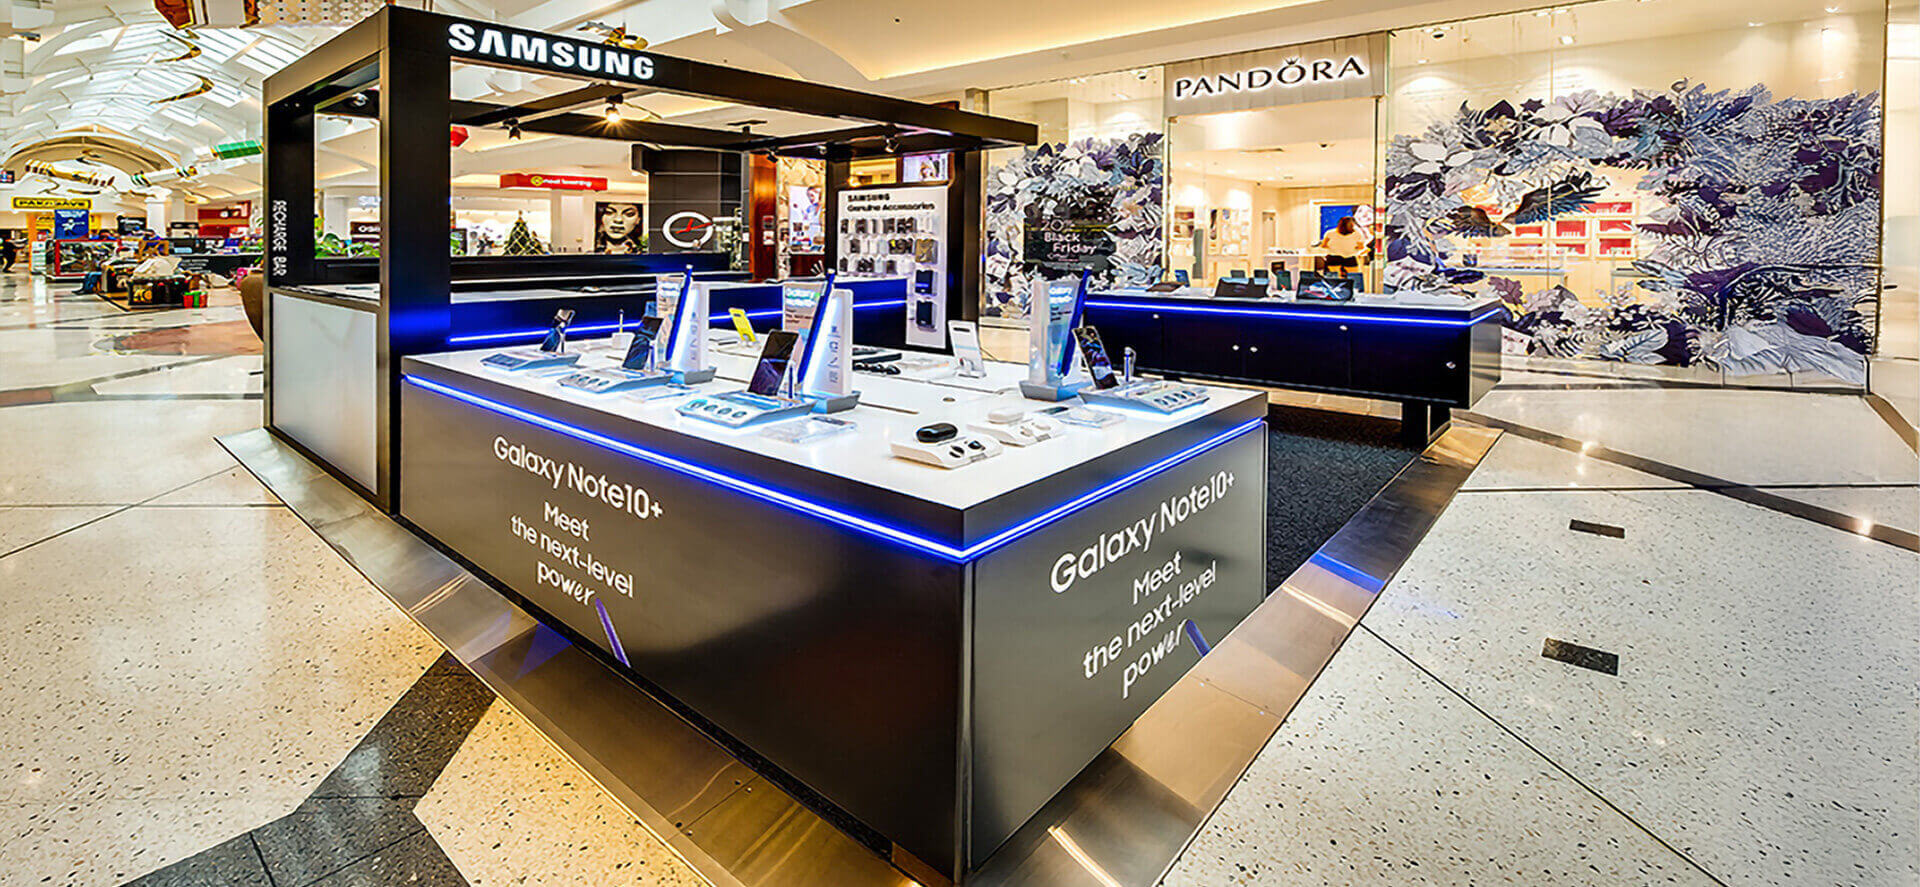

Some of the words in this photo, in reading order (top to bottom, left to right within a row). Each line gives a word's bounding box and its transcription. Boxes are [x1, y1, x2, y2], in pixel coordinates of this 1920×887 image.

[448, 23, 655, 80] SAMSUNG
[1175, 56, 1366, 98] PANDORA
[847, 193, 891, 202] SAMSUNG
[847, 204, 881, 212] Genuine
[882, 202, 935, 211] Accessories
[272, 200, 288, 251] RECHARGE
[1043, 231, 1080, 243] Black
[1052, 242, 1097, 255] Friday
[272, 256, 288, 276] BAR
[493, 436, 564, 489] Galaxy
[567, 461, 663, 520] Note10+
[544, 501, 590, 542] Meet
[1050, 511, 1156, 594] Galaxy
[1159, 470, 1235, 533] Note10+
[510, 514, 538, 545] the
[540, 532, 634, 599] next-level
[1132, 550, 1182, 605] Meet
[536, 560, 595, 606] power
[1082, 634, 1123, 679] the
[1127, 559, 1217, 648] next-level
[1122, 618, 1188, 699] power
